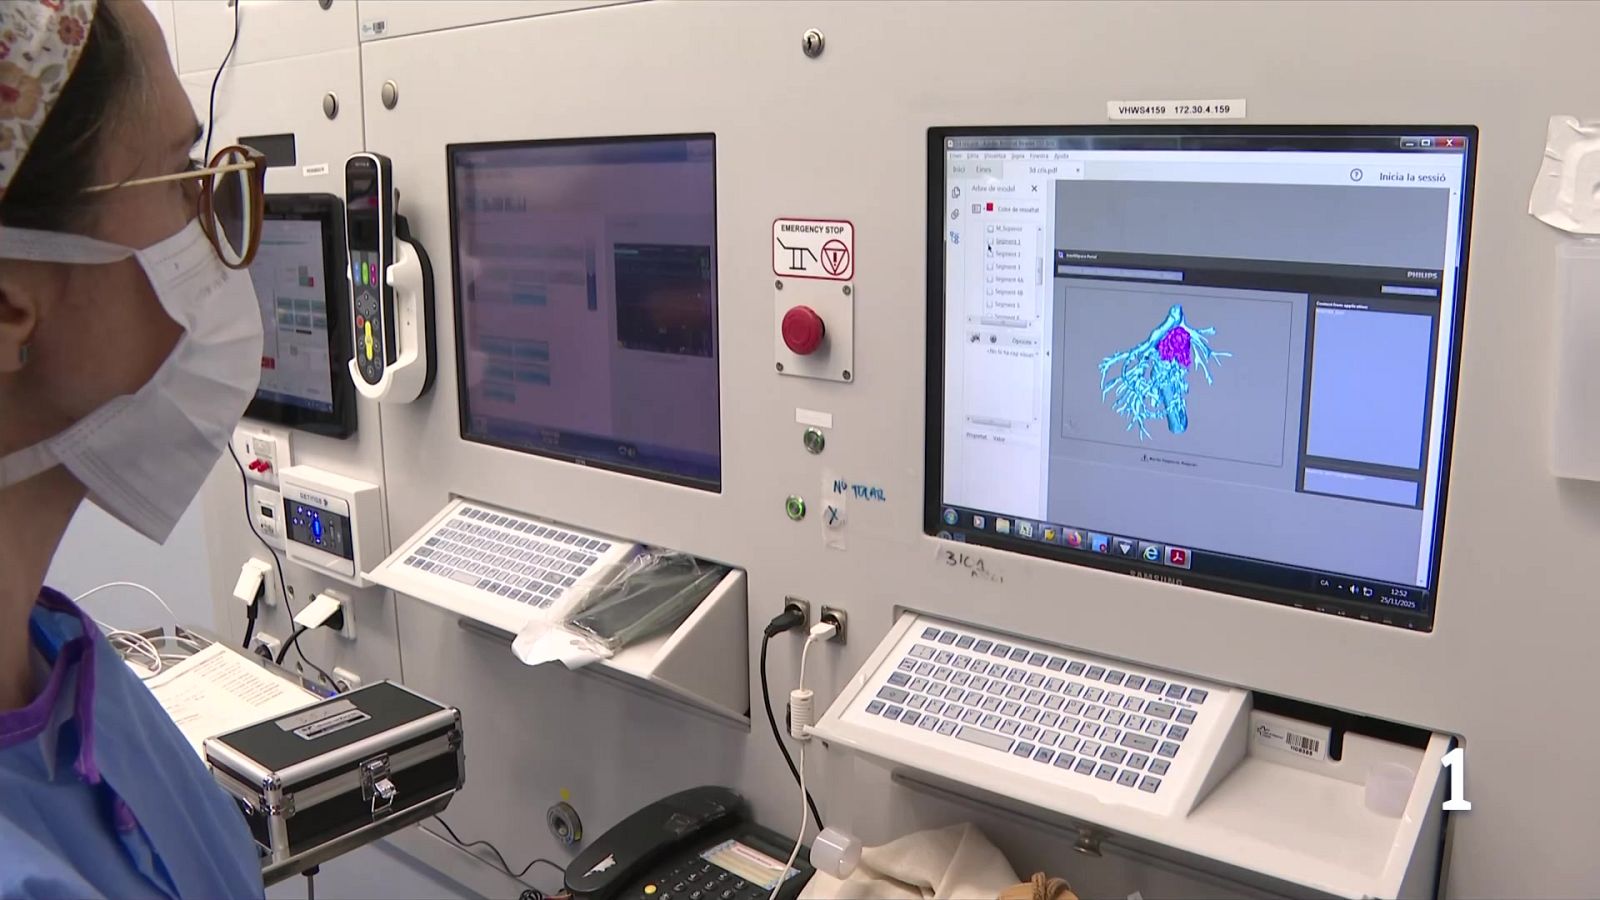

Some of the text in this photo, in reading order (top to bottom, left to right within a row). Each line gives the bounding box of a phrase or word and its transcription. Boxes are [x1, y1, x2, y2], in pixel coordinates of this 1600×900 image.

[1118, 104, 1231, 115] VHWS4159 172.30.4.159
[1379, 171, 1446, 183] Inicia la sessió
[989, 184, 996, 192] de
[781, 224, 844, 234] EMERGENCY STOP
[1407, 271, 1438, 279] PHILIPS
[833, 479, 886, 502] NO TOCAR
[1129, 569, 1183, 586] SAMSUNG
[1320, 579, 1329, 587] CA
[1391, 588, 1408, 597] 12:52
[1380, 597, 1416, 608] 25/11/2025
